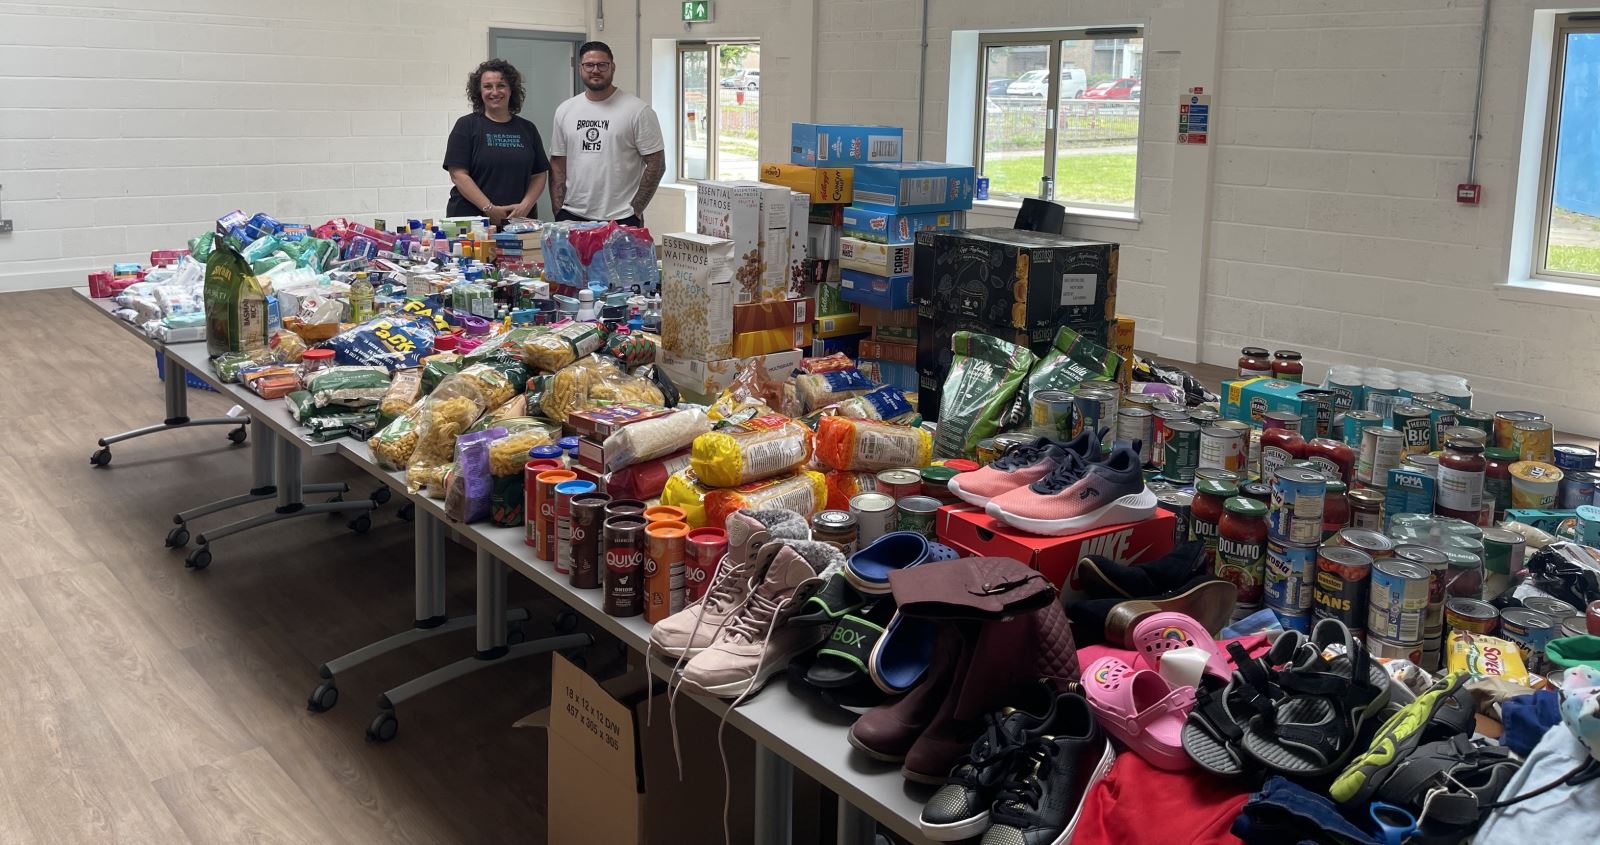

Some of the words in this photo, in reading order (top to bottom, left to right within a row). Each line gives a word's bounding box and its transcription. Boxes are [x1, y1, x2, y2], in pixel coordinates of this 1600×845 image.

[576, 119, 609, 131] BROOKLYN
[582, 140, 601, 151] NETS
[698, 186, 731, 199] ESSENTIAL
[698, 197, 731, 210] WAITROSE
[702, 215, 718, 226] FRUIT
[663, 239, 707, 254] ESSENTIAL
[664, 251, 708, 266] WAITROSE
[894, 248, 903, 274] CORN
[676, 270, 693, 282] RICE
[686, 284, 705, 295] POPS
[1068, 363, 1087, 376] Laila
[1409, 429, 1430, 441] BIG
[1268, 450, 1286, 462] HEINZ
[1395, 473, 1422, 486] MOMA
[1196, 519, 1218, 536] DOL
[1219, 536, 1260, 560] DOLMIO
[1313, 588, 1351, 611] EANS
[566, 686, 573, 699] 18
[576, 695, 579, 704] x
[582, 697, 589, 711] 12
[591, 706, 594, 714] x
[597, 710, 604, 724] 12
[605, 718, 620, 736] D/W
[567, 703, 579, 718] 457
[581, 714, 584, 724] x
[586, 719, 597, 735] 305
[600, 730, 604, 740] x
[605, 733, 619, 750] 305
